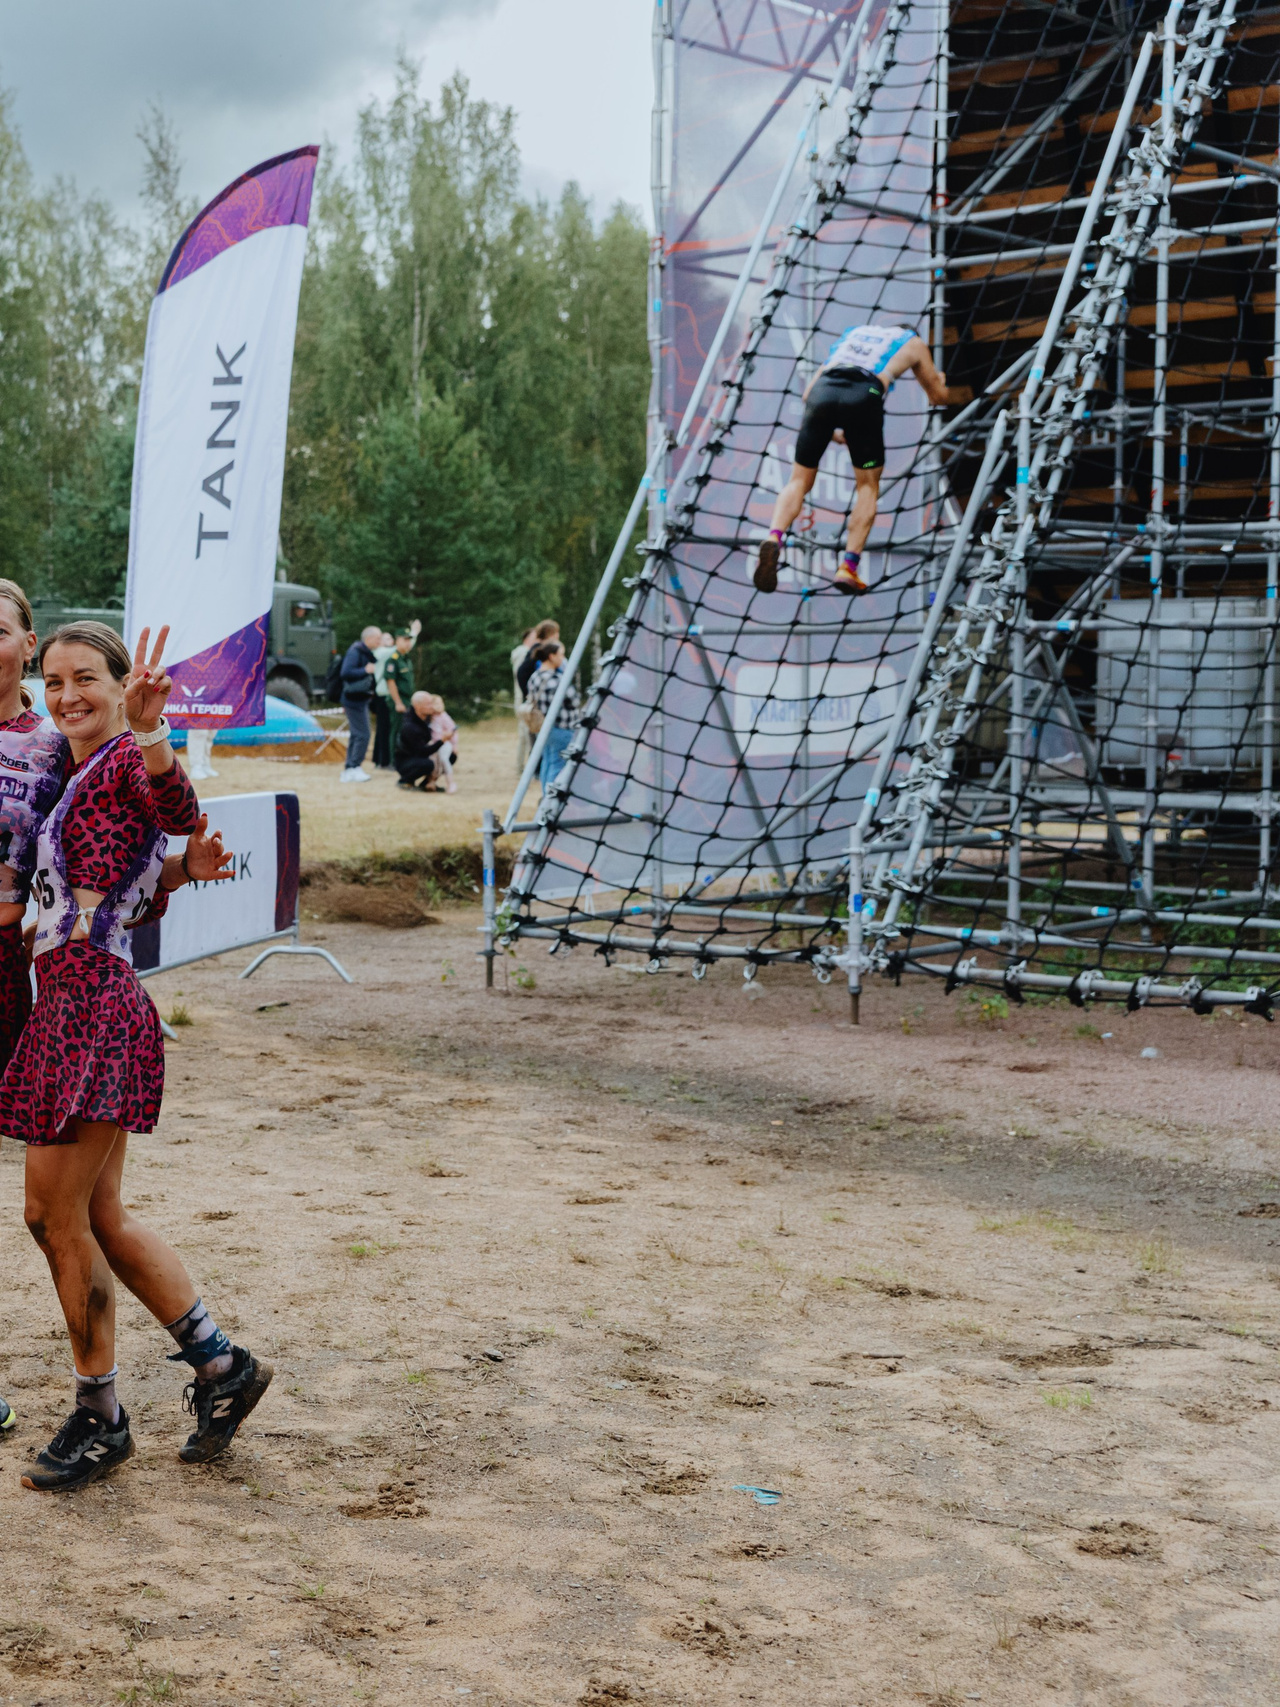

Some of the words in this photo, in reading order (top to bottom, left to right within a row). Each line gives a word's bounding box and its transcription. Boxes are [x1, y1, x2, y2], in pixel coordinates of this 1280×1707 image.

[196, 341, 247, 560] TANK
[162, 703, 188, 714] НКА
[192, 703, 233, 715] ГЕРОЕВ
